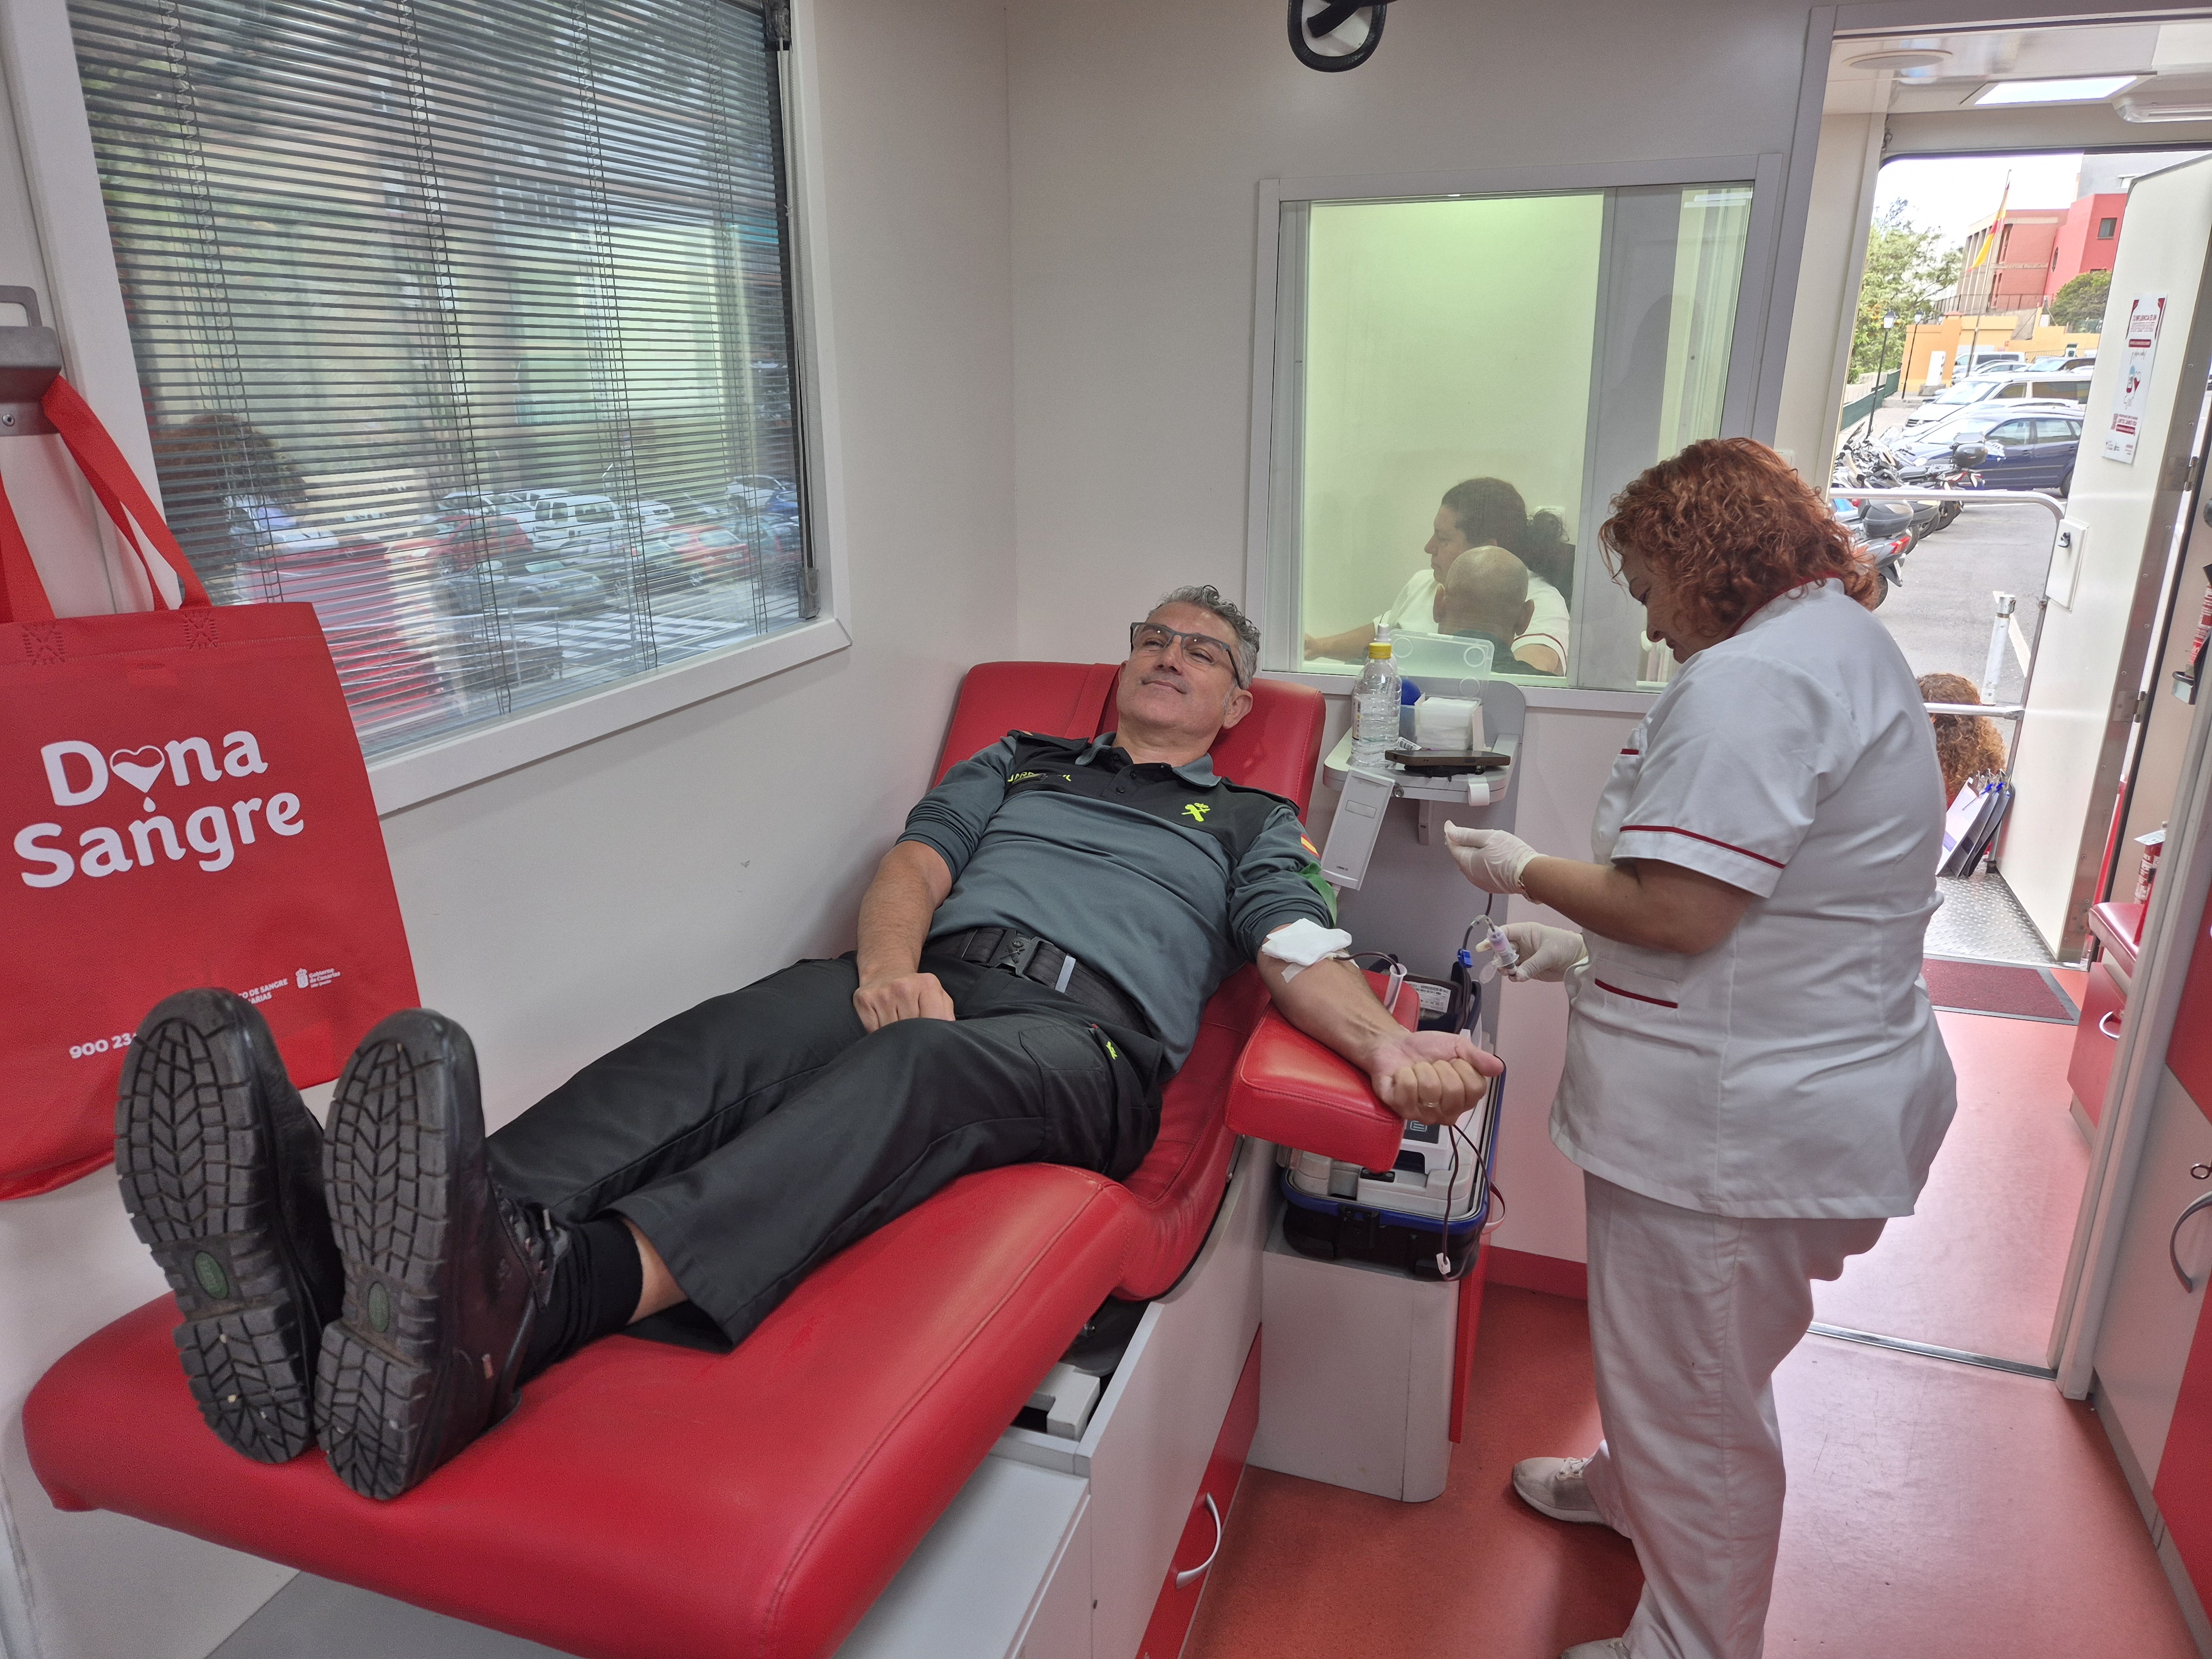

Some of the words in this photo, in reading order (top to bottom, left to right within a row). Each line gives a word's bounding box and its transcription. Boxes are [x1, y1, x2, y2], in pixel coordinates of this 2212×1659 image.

[14, 792, 304, 888] Sangre
[248, 992, 272, 1004] ARIAS
[249, 988, 260, 997] DE
[260, 978, 288, 993] SANGRE
[69, 1039, 109, 1059] 900
[111, 1032, 137, 1050] 23
